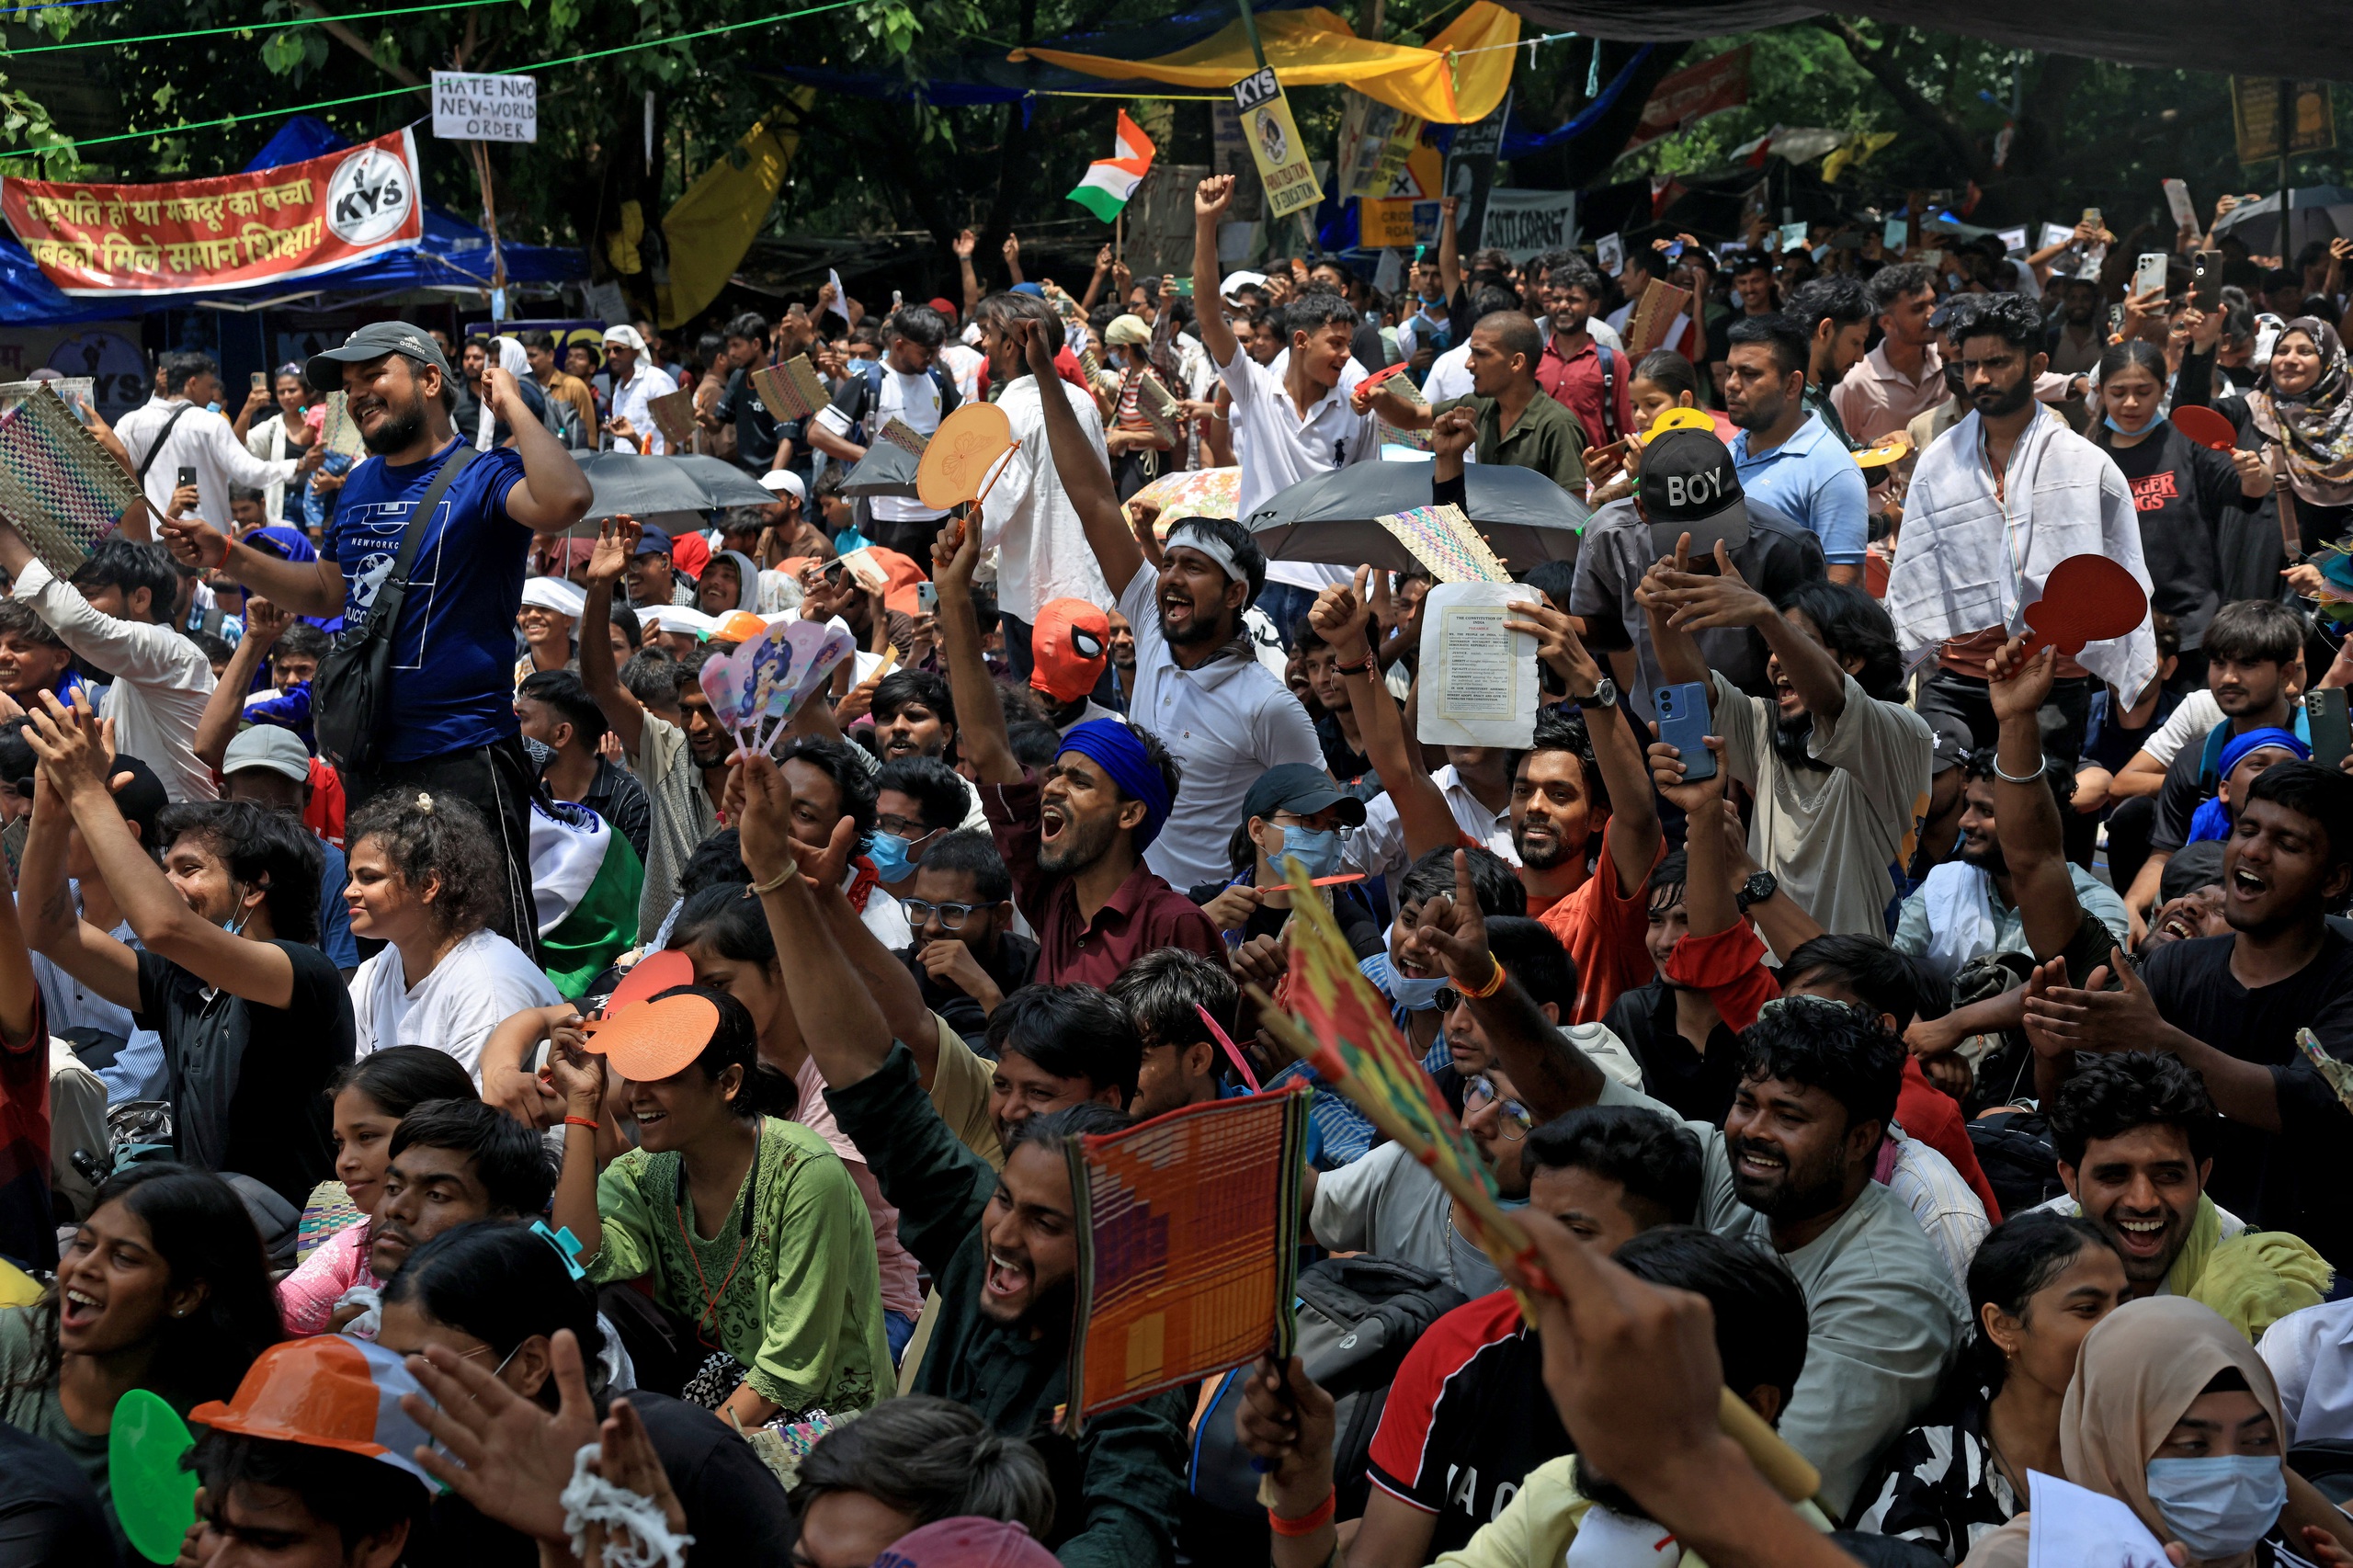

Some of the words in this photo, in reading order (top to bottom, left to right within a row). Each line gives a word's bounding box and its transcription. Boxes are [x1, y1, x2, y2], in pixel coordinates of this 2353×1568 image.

[439, 77, 494, 96] HATE
[1233, 70, 1276, 108] KYS
[466, 119, 525, 138] ORDER
[25, 190, 102, 231] राष्ट्रपति
[104, 192, 129, 230] हो
[129, 200, 160, 226] या
[226, 189, 259, 217] का
[258, 178, 313, 211] बच्चा
[336, 178, 403, 222] KYS
[1381, 210, 1414, 223] CROS
[1385, 225, 1415, 239] ROA
[100, 232, 163, 273] मिले
[165, 236, 239, 273] समान
[399, 340, 426, 355] adidas
[1667, 466, 1722, 506] BOY
[351, 538, 400, 550] NEWYORKC
[344, 606, 368, 623] SUCC
